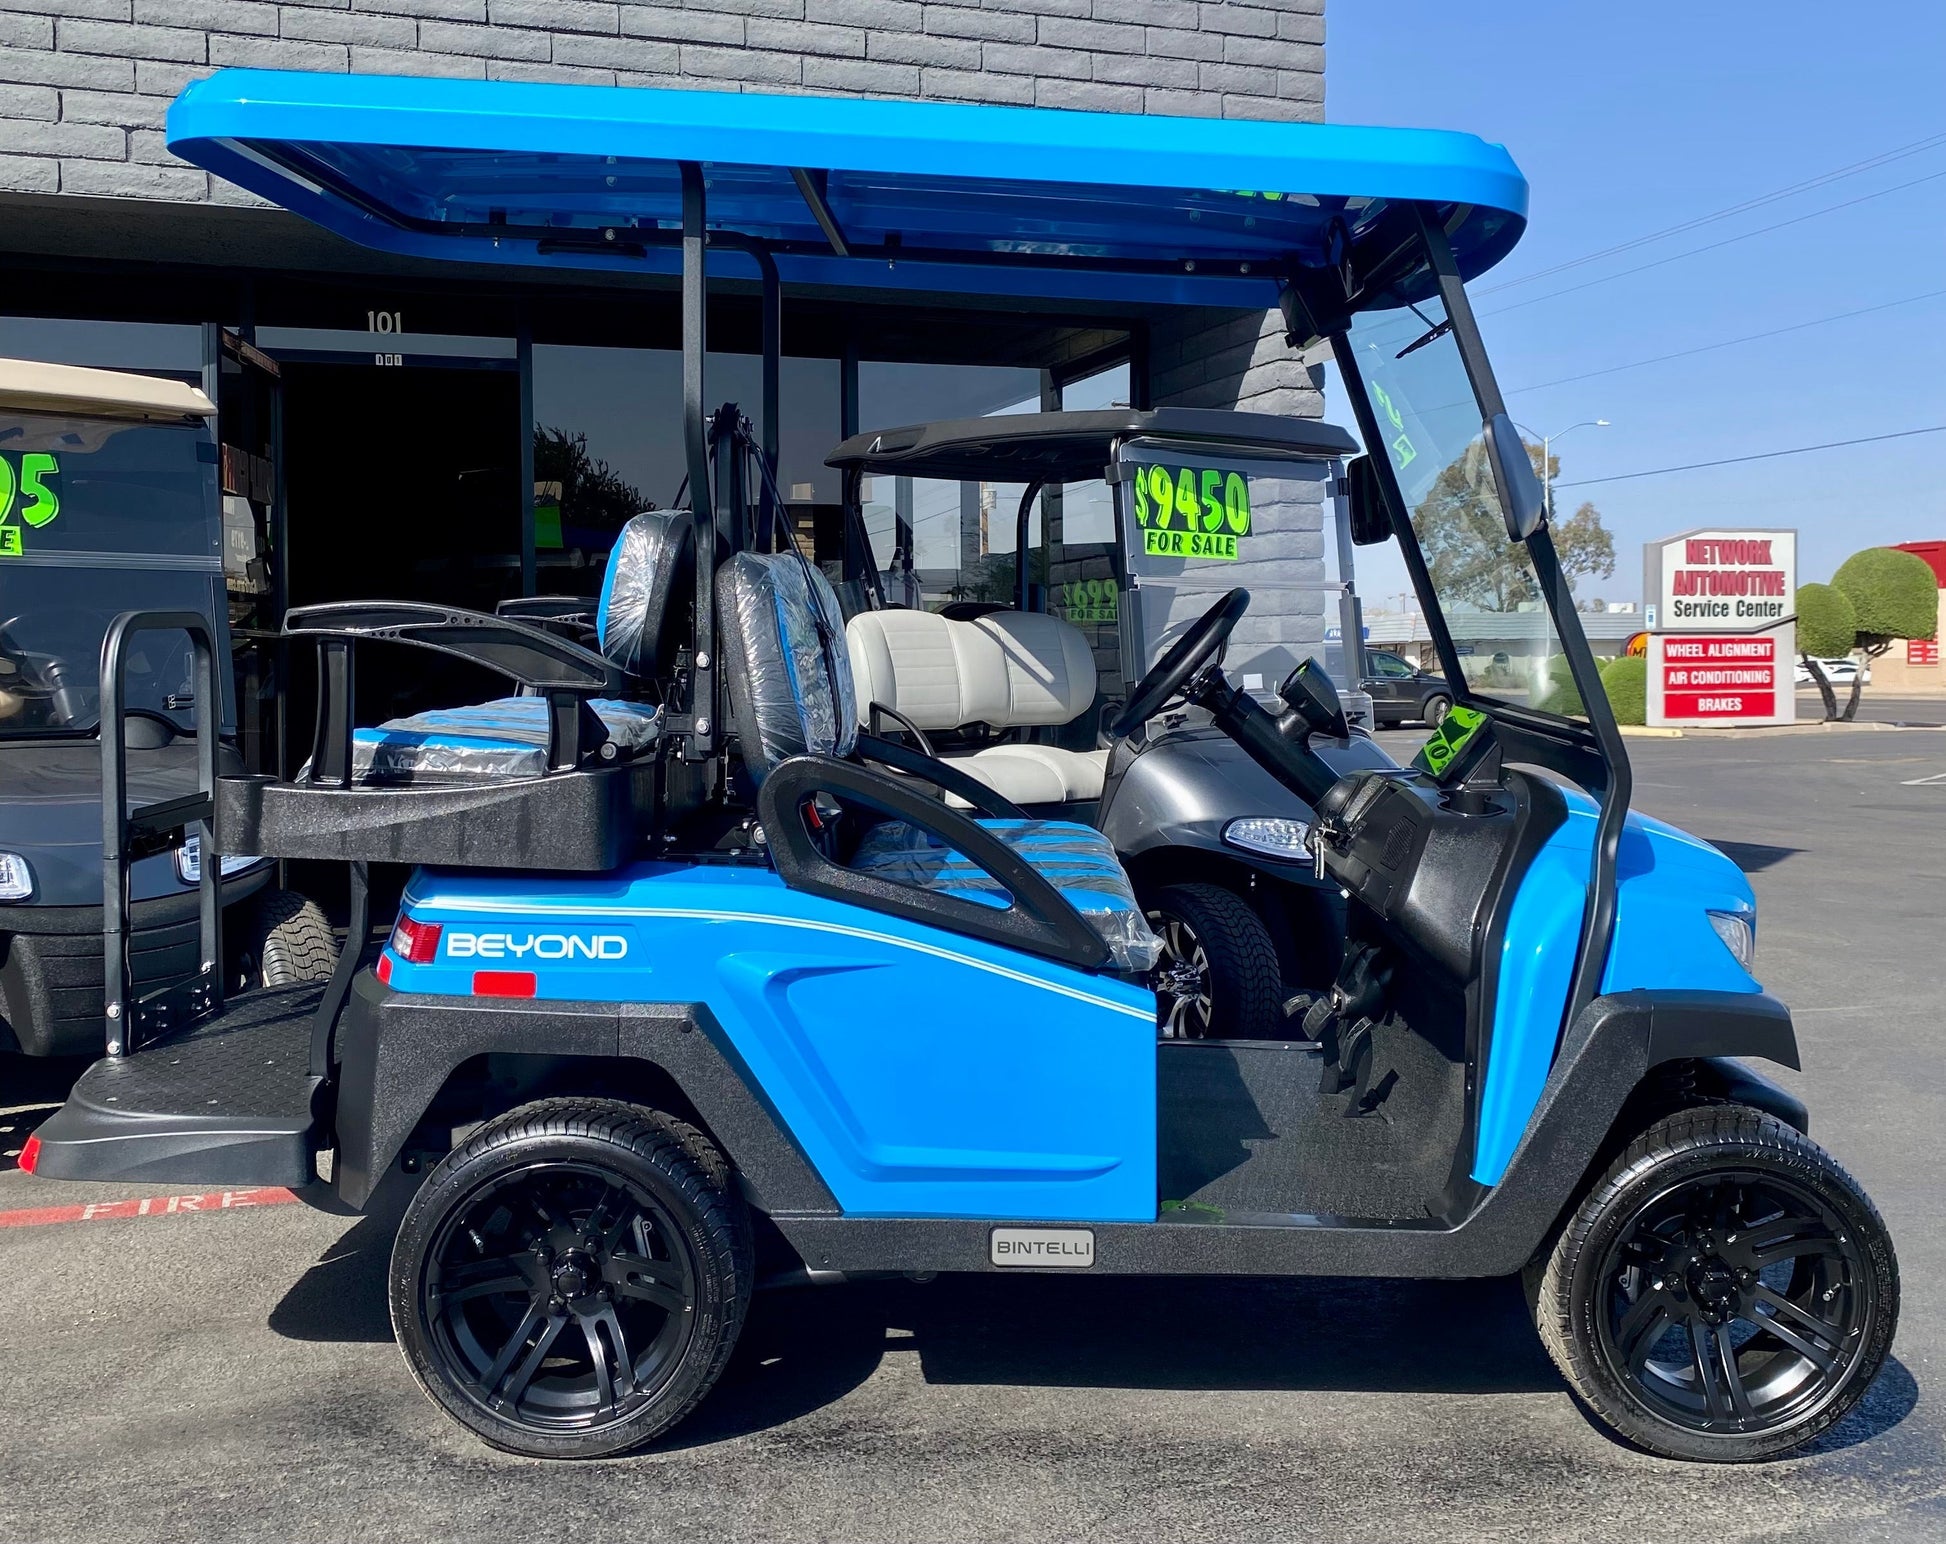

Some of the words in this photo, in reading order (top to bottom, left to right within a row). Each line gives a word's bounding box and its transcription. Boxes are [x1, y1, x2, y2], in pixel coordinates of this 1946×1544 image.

[368, 311, 402, 334] 101
[1135, 464, 1250, 536] $9450
[1146, 531, 1183, 554] FOR
[1191, 533, 1236, 557] SALE
[1685, 539, 1773, 565] NETWORK
[1672, 570, 1785, 596] AUTOMOTIVE
[1673, 600, 1730, 617] Service
[1736, 600, 1784, 617] Center
[1666, 644, 1706, 657] WHEEL
[1707, 643, 1772, 657] ALIGNMENT
[1668, 671, 1688, 684] AIR
[1690, 670, 1771, 684] CONDITIONING
[1697, 697, 1743, 712] BRAKES
[447, 932, 628, 960] BEYOND
[82, 1189, 259, 1220] FIRE
[997, 1240, 1090, 1256] BINTELLI
